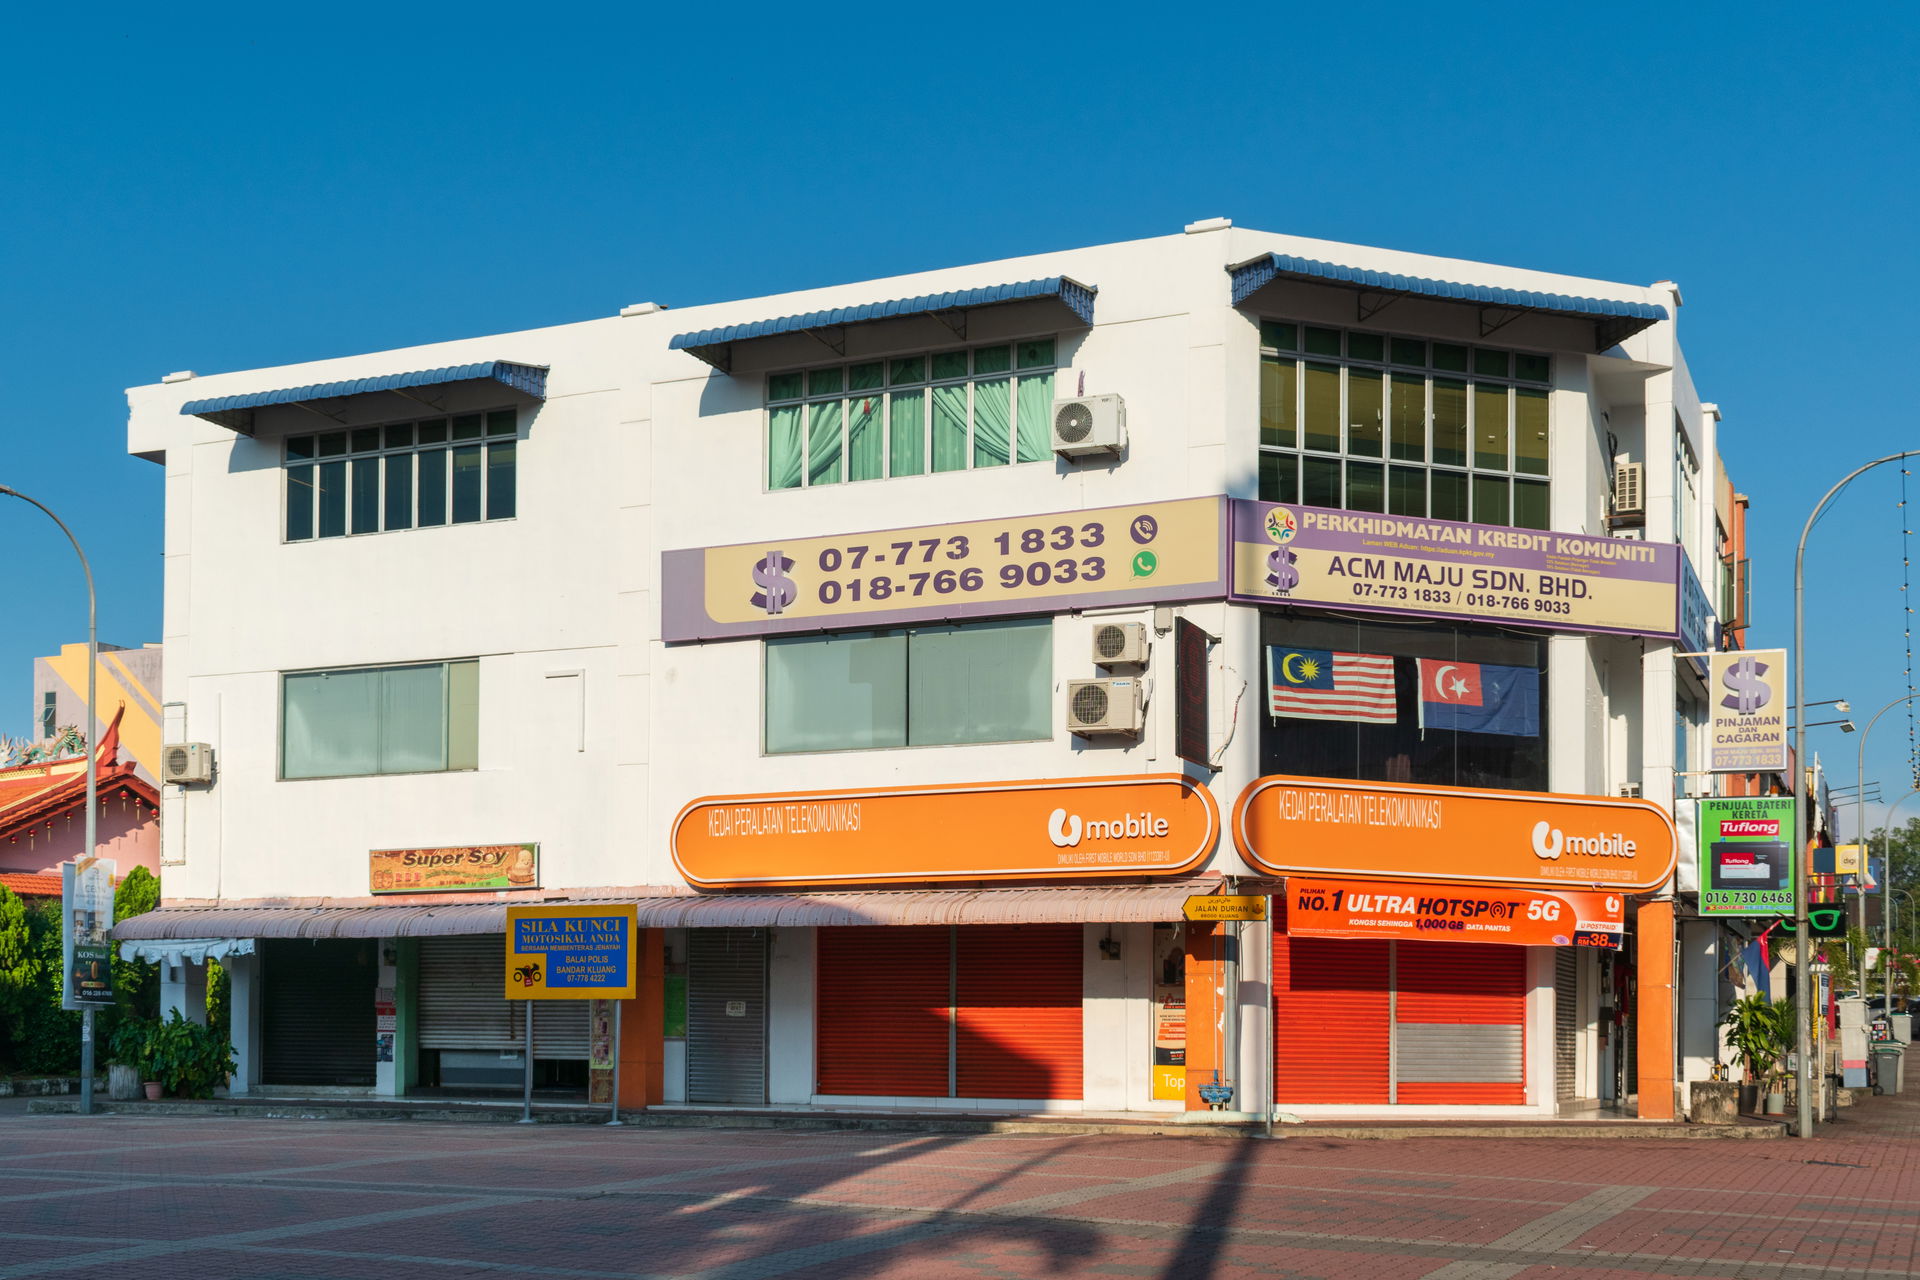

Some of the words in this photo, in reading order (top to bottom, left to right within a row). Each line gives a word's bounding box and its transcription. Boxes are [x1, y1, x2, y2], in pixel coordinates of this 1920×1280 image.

[1303, 512, 1471, 544] PERKHIDMATAN
[1478, 531, 1551, 552] KREDIT
[1556, 538, 1655, 563] KOMUNITI
[818, 535, 970, 573] 07-773
[994, 522, 1106, 557] 1833
[818, 567, 985, 605] 018-766
[999, 555, 1106, 588] 9033
[1327, 556, 1385, 580] ACM
[1394, 561, 1464, 586] MAJU
[1472, 569, 1530, 593] SDN.
[1539, 575, 1592, 599] BHD.
[1353, 582, 1408, 600] 07-773
[1414, 588, 1451, 604] 1833
[1466, 593, 1529, 610] 018-766
[1534, 600, 1570, 614] 9033
[1716, 716, 1780, 727] PINJAMAN
[1716, 732, 1780, 743] CAGARAN
[1715, 755, 1752, 766] 07-773
[1756, 754, 1782, 765] 1833
[1279, 790, 1307, 820] KEDAI
[1308, 792, 1362, 824] PERALATAN
[1363, 795, 1442, 829] TELEKOMUNIKASI
[1709, 801, 1753, 810] PENJUAL
[1756, 801, 1791, 809] BATERI
[708, 809, 734, 837] KEDAI
[735, 806, 784, 836] PERALATAN
[785, 802, 861, 834] TELEKOMUNIKASI
[1732, 810, 1768, 819] KERETA
[1086, 812, 1169, 839] mobile
[1721, 822, 1779, 834] Tuflong
[1565, 832, 1637, 858] mobile
[403, 852, 465, 867] Super
[468, 849, 508, 866] Soy
[1705, 892, 1729, 903] 016
[1734, 892, 1757, 903] 730
[1761, 892, 1793, 903] 6468
[1347, 894, 1416, 914] ULTRA
[1527, 899, 1561, 921] 5G
[521, 920, 559, 933] SILA
[565, 919, 620, 932] KUNCI
[1348, 918, 1376, 926] KONGSI
[1377, 919, 1413, 928] SEHINGGA
[1415, 918, 1447, 930] 1,000
[1466, 923, 1484, 931] DATA
[1485, 924, 1511, 933] PANTAS
[521, 934, 587, 944] MOTOSIKAL
[590, 933, 620, 943] ANDA
[587, 955, 609, 963] POLIS
[556, 966, 586, 974] BANDAR
[587, 965, 616, 973] KLUANG
